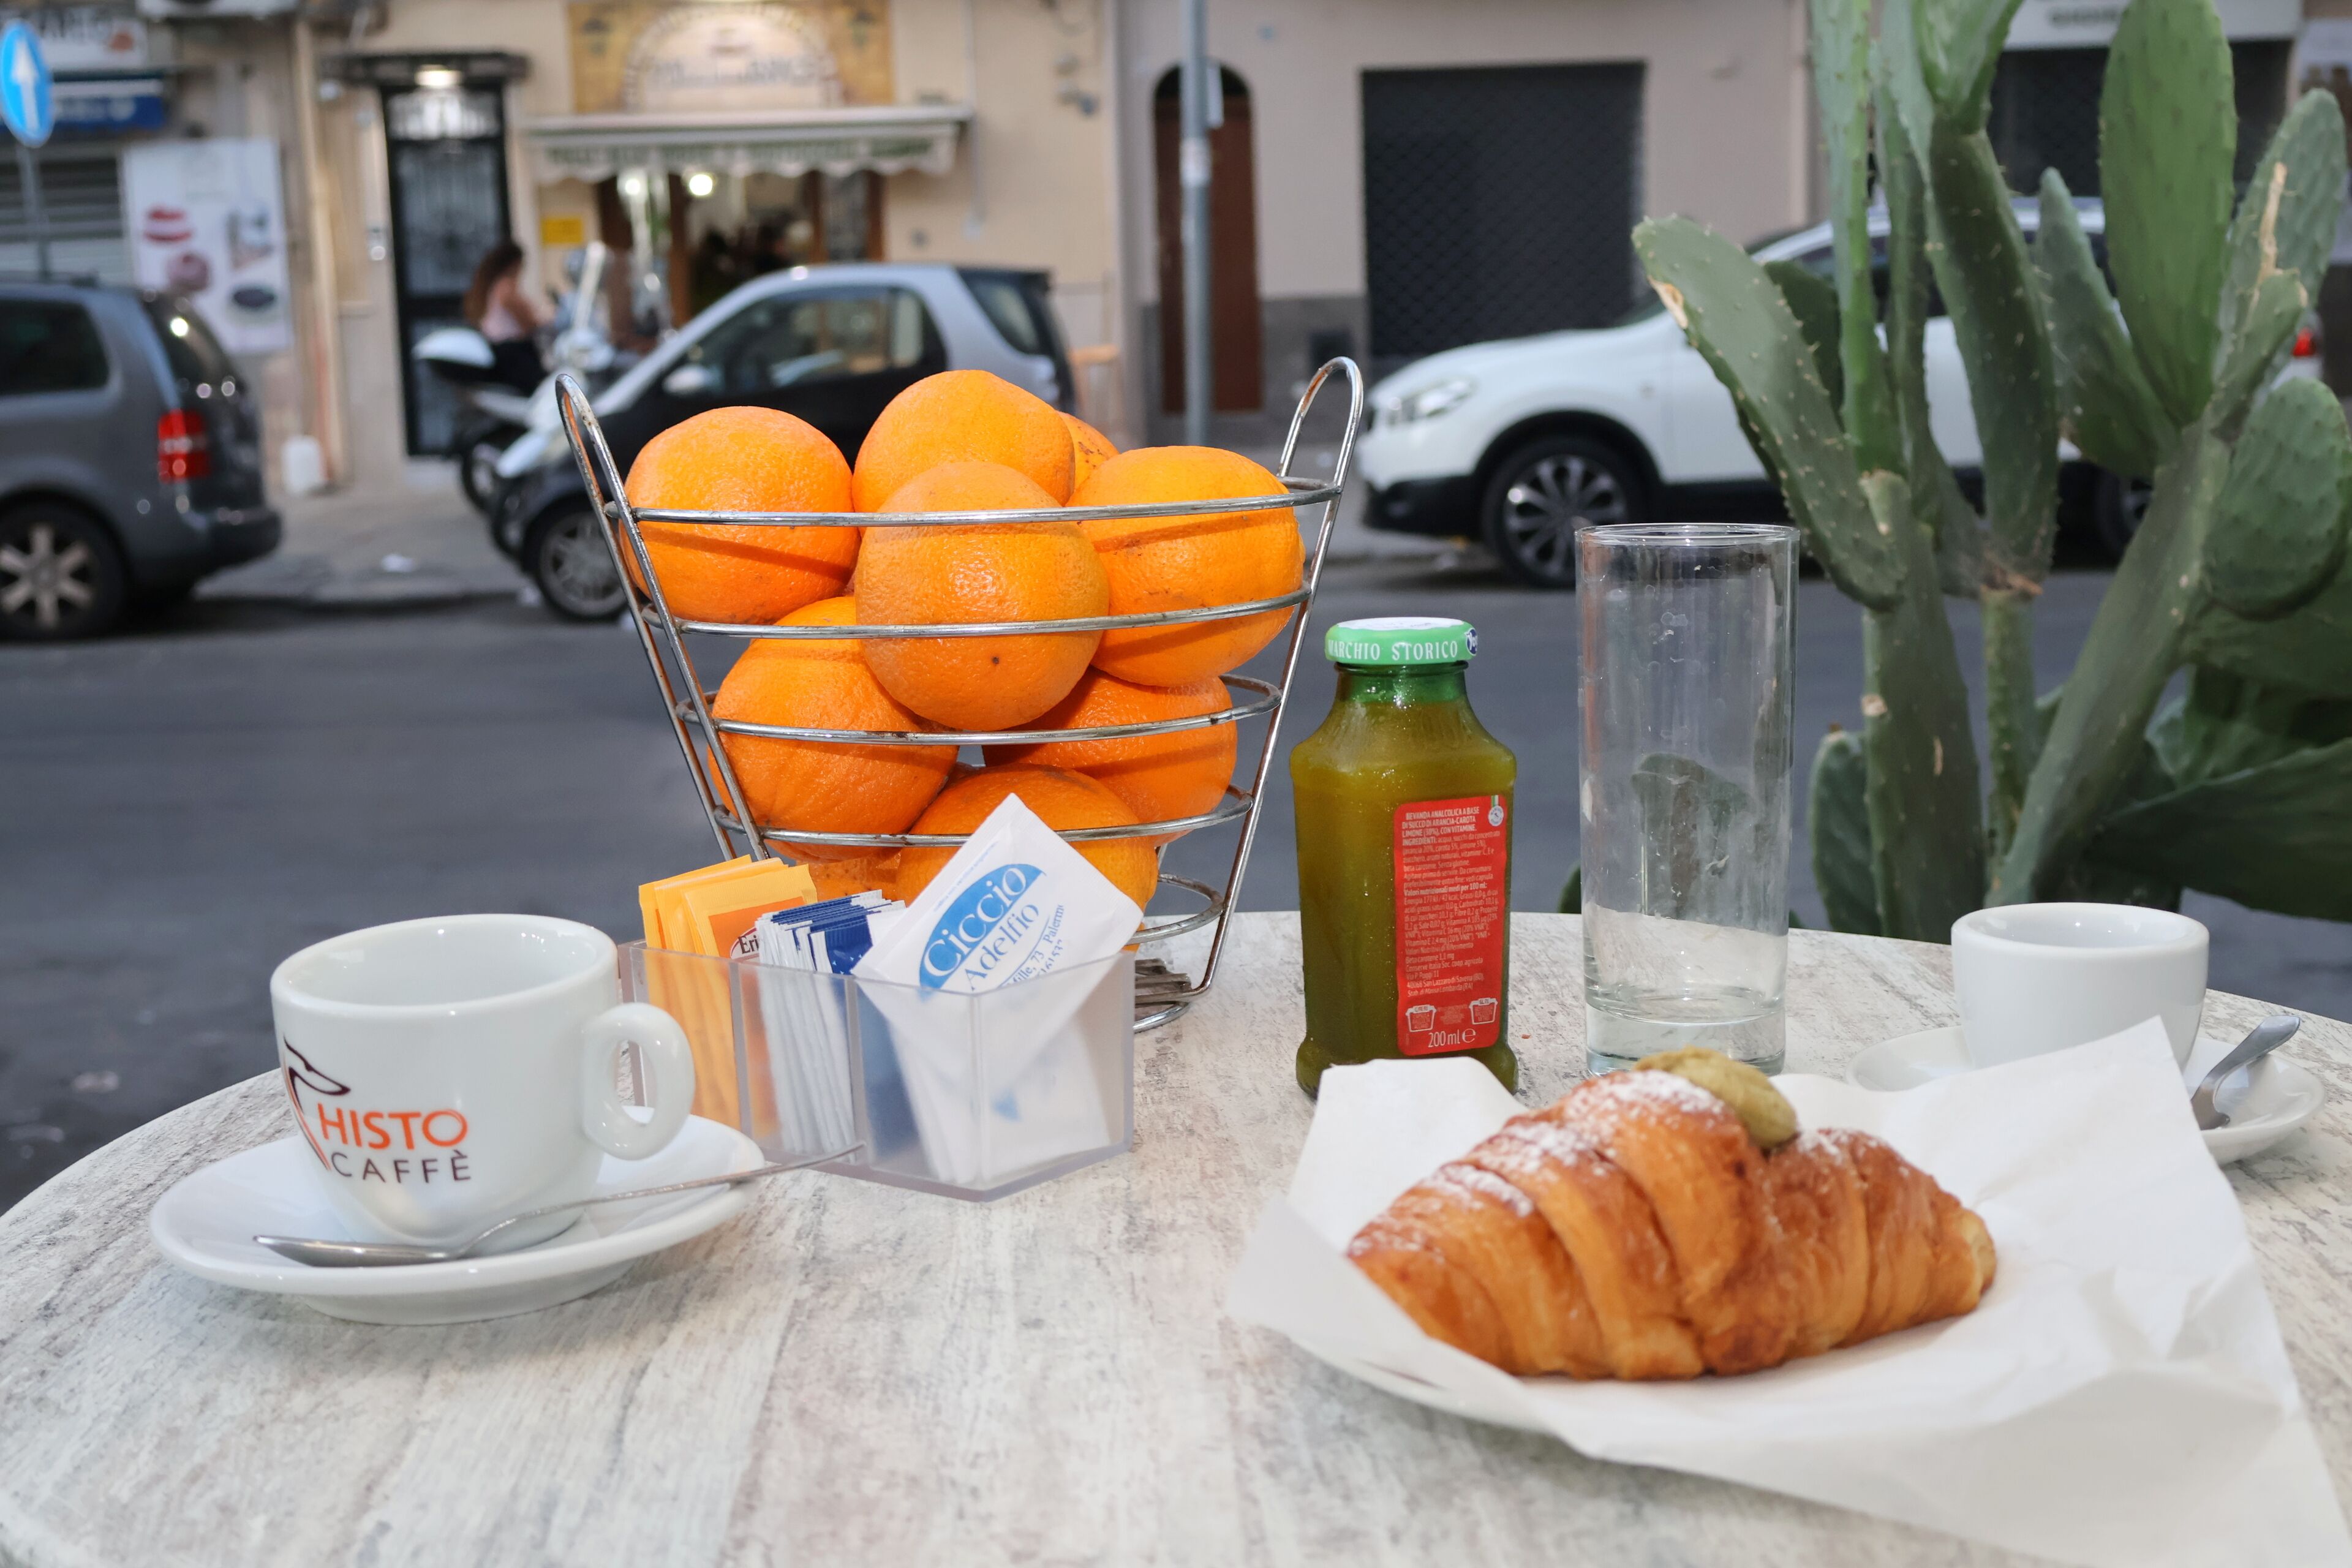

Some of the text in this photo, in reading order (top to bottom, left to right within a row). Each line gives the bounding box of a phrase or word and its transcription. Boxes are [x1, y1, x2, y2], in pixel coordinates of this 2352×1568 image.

[1327, 639, 1458, 661] MARCHIO STORICO
[1430, 808, 1461, 818] ANALCOLICA
[1451, 824, 1477, 832] VITAMINE.
[924, 867, 1027, 977] Ciccio
[1031, 950, 1044, 963] 73
[1042, 904, 1065, 944] Palerm
[965, 904, 1039, 991] Adelfio
[1428, 1031, 1446, 1047] 200
[1447, 1029, 1460, 1045] ml
[317, 1102, 469, 1150] HISTO
[331, 1150, 471, 1184] CAFFÈ
